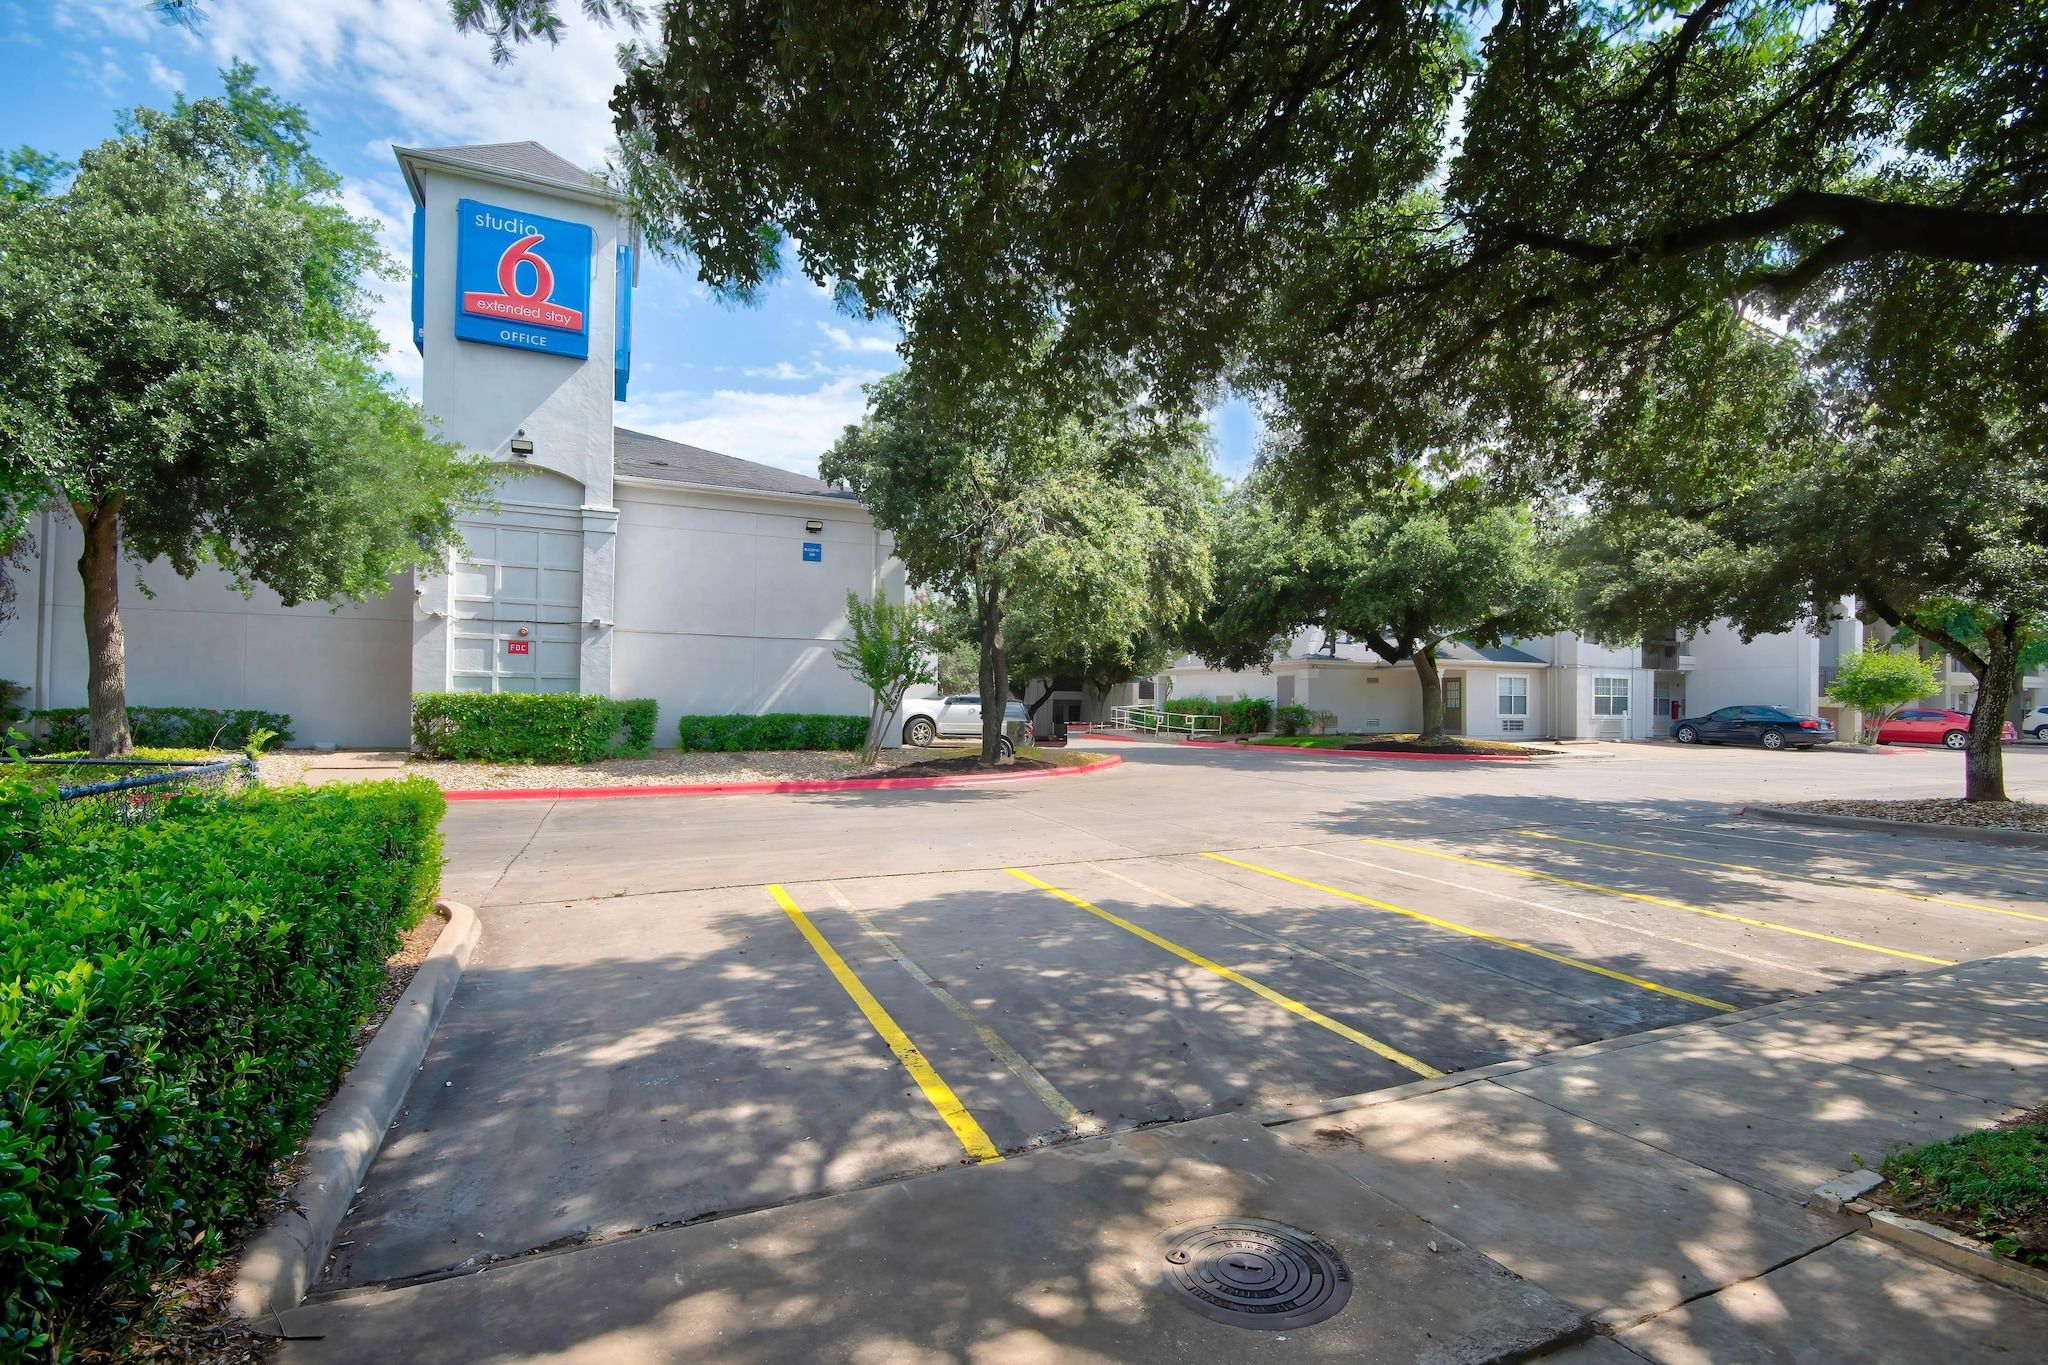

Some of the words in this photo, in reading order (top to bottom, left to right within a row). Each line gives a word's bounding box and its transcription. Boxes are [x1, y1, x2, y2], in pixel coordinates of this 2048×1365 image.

[475, 212, 538, 236] studio
[497, 234, 555, 303] 6
[477, 299, 541, 319] extended
[545, 312, 572, 326] stay
[500, 330, 547, 347] OFFICE
[510, 644, 526, 652] FDC
[1223, 1241, 1274, 1255] SEWER
